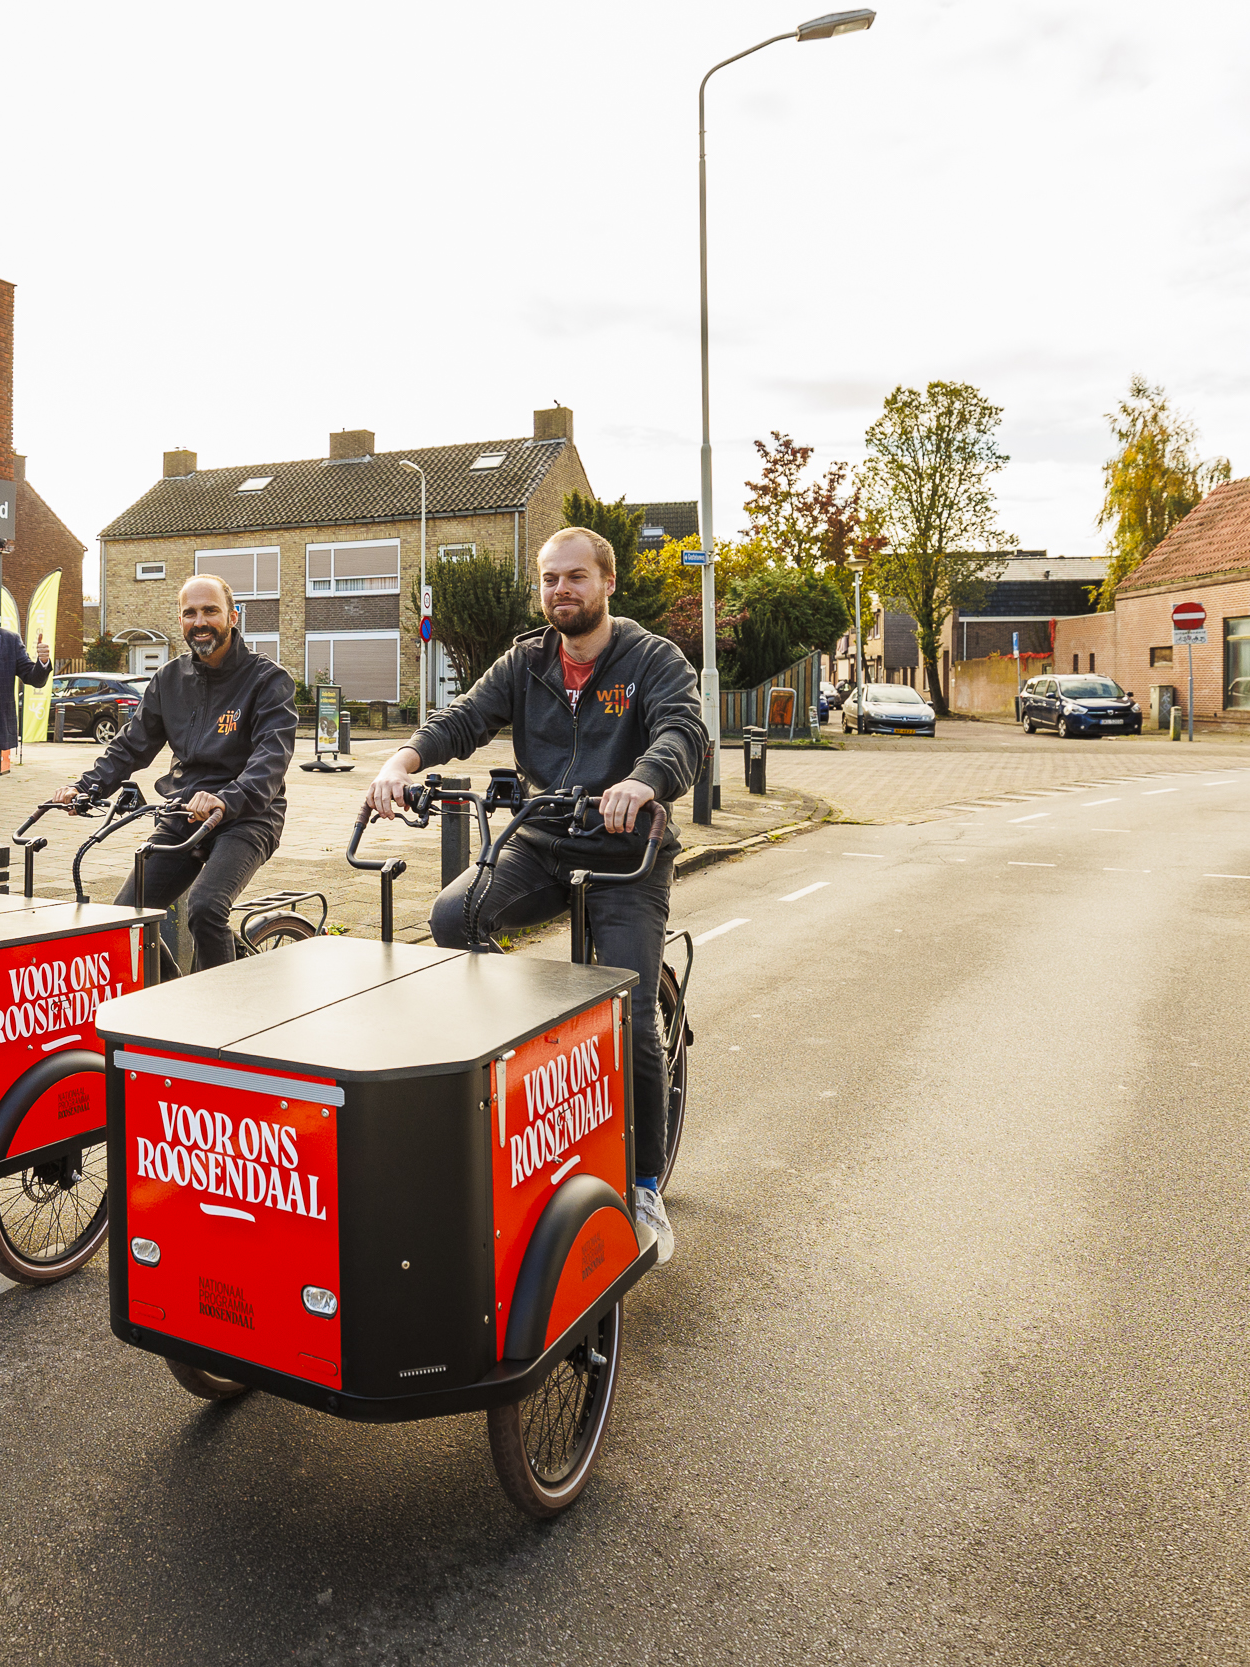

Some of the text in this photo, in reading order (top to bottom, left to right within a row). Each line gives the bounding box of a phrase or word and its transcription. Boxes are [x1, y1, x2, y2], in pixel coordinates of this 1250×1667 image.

[597, 684, 625, 706] wij
[8, 952, 110, 1003] VOOR ONS
[524, 1035, 600, 1122] VOOR ONS
[157, 1101, 299, 1166] VOOR ONS
[510, 1075, 612, 1188] ROOSENDAAL
[136, 1137, 326, 1220] ROOSENDAAL
[199, 1276, 246, 1301] NATIONAAL
[199, 1289, 254, 1316] PROGRAMMA
[199, 1302, 255, 1330] ROOSENDAAL
